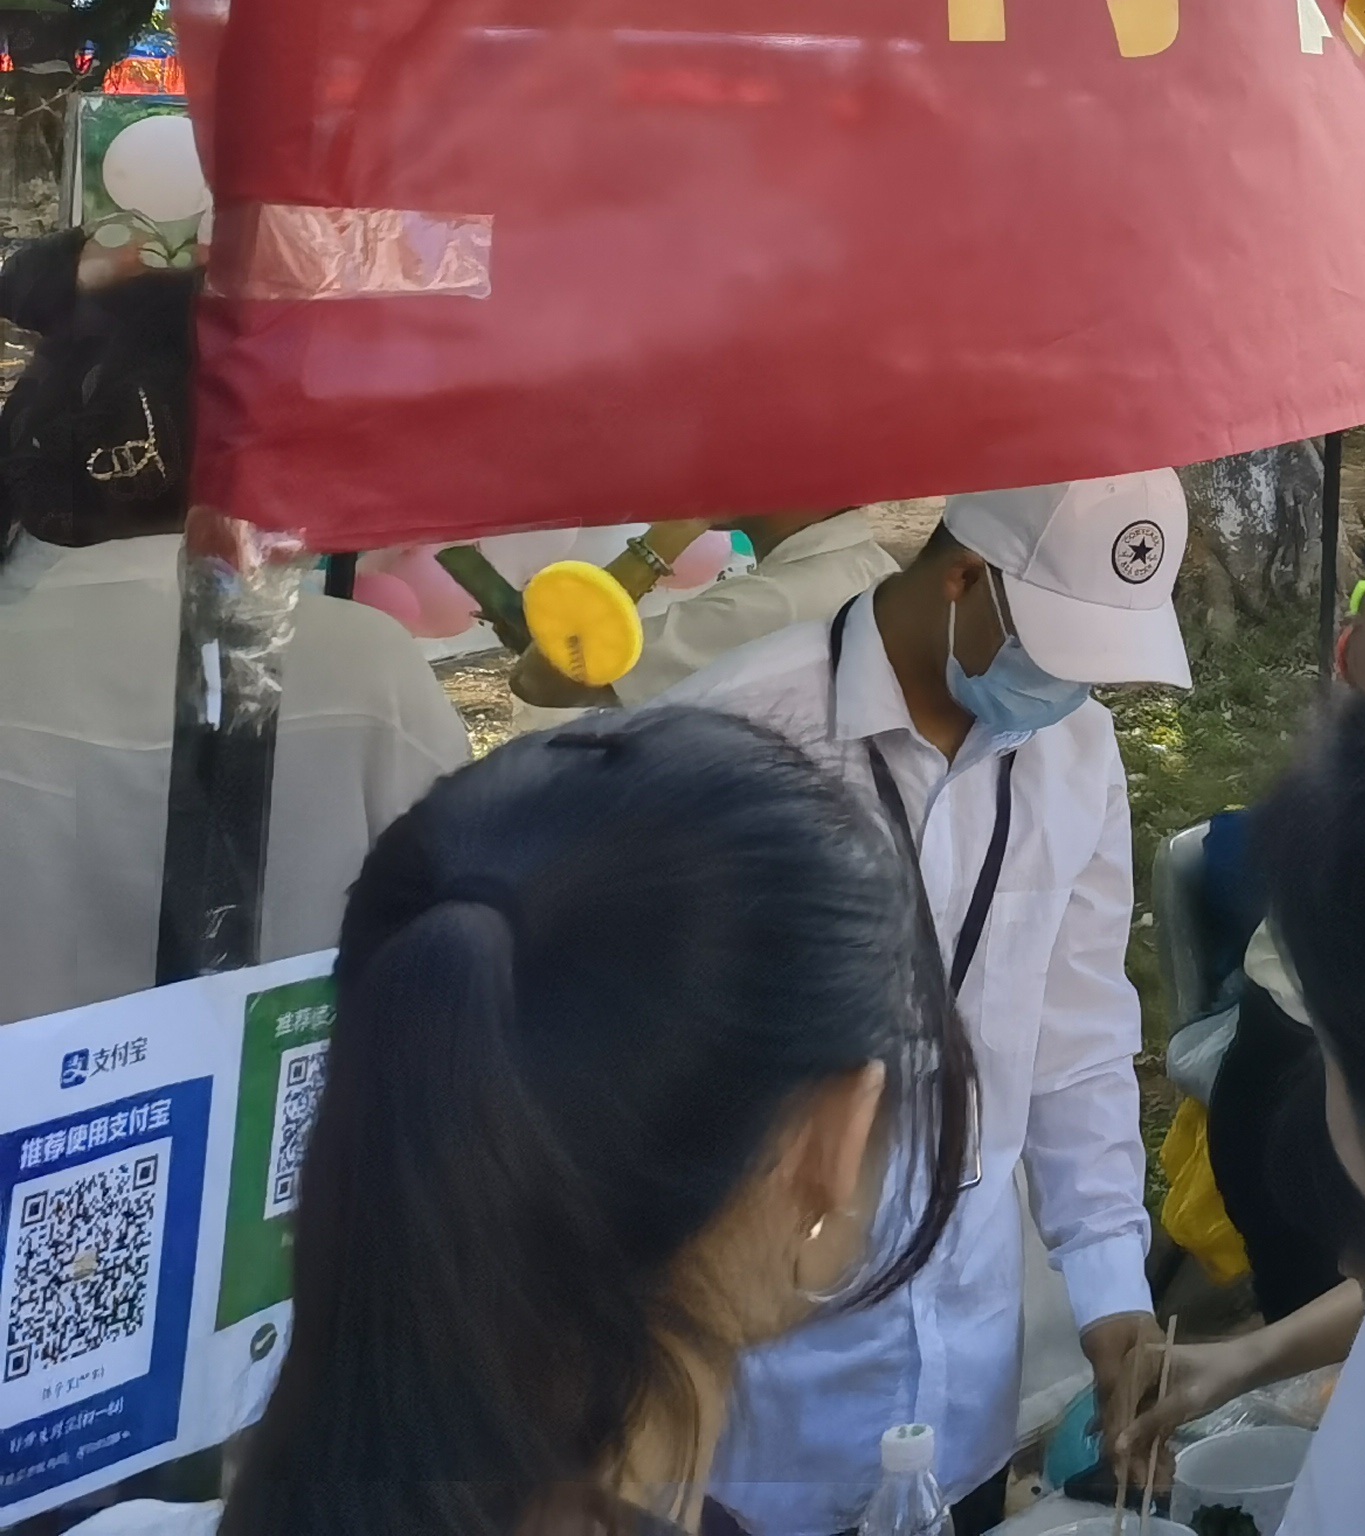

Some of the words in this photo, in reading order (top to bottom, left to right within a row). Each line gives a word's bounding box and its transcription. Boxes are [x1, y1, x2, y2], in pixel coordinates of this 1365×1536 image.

[89, 1036, 149, 1078] 支付宝
[19, 1097, 173, 1171] 推荐使用支付宝
